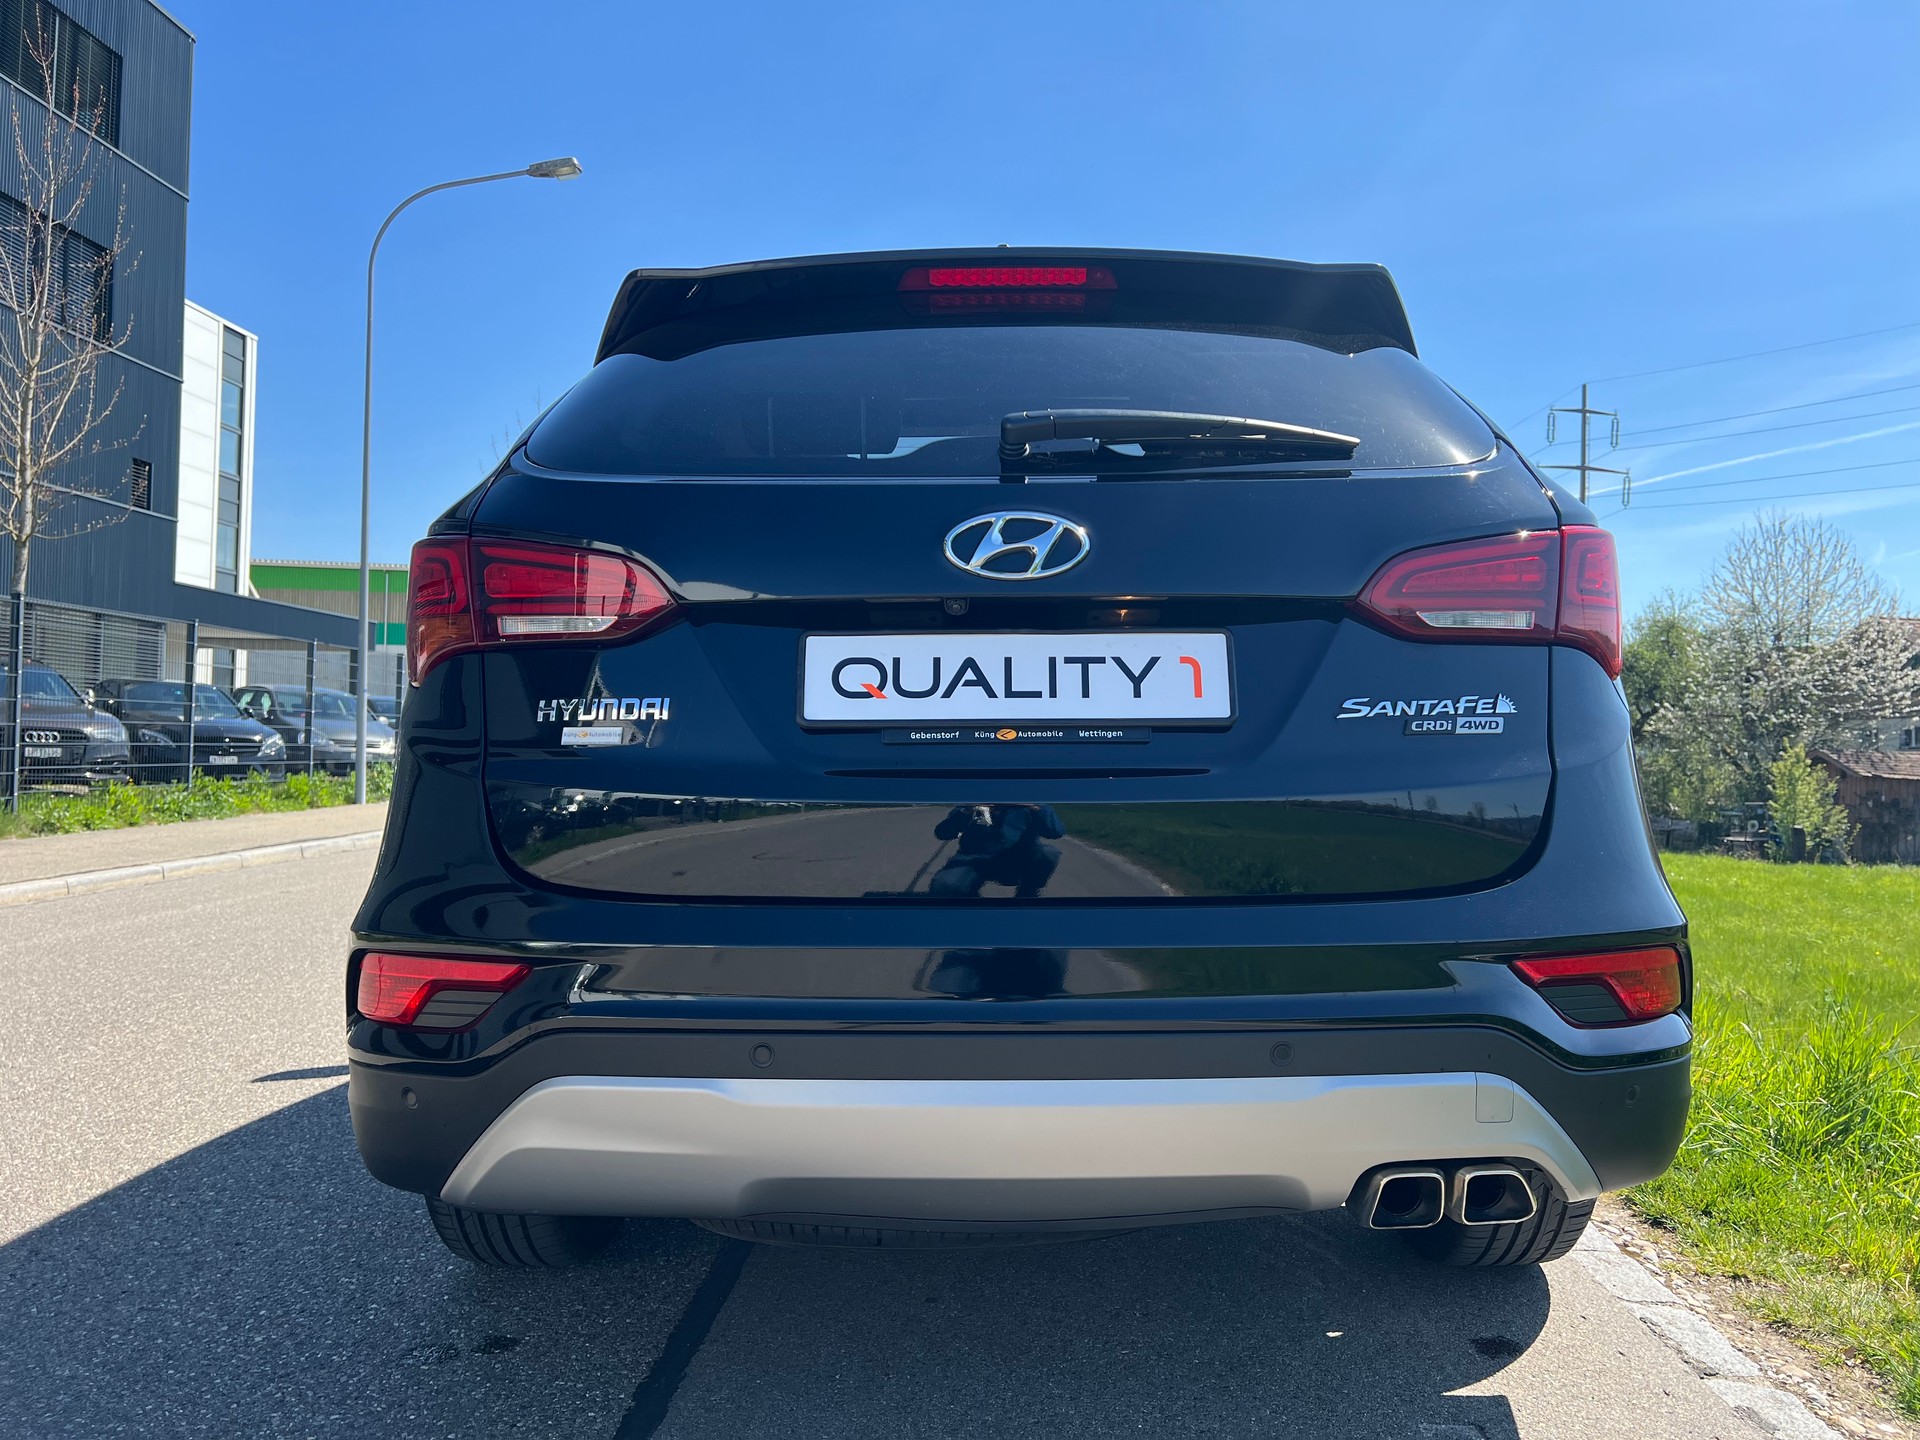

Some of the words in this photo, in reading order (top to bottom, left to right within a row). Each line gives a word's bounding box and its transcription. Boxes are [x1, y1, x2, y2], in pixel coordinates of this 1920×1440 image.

[831, 656, 1162, 699] QUALITY
[1179, 656, 1203, 699] 1
[536, 698, 670, 721] HYUNDAI
[1411, 720, 1452, 731] CRDi
[1459, 720, 1500, 731] 4WD
[588, 730, 622, 738] Automobile
[910, 731, 960, 740] Gebenstorf
[974, 731, 995, 740] Küng
[1018, 730, 1064, 738] Automobile
[1079, 730, 1123, 739] Wettingen
